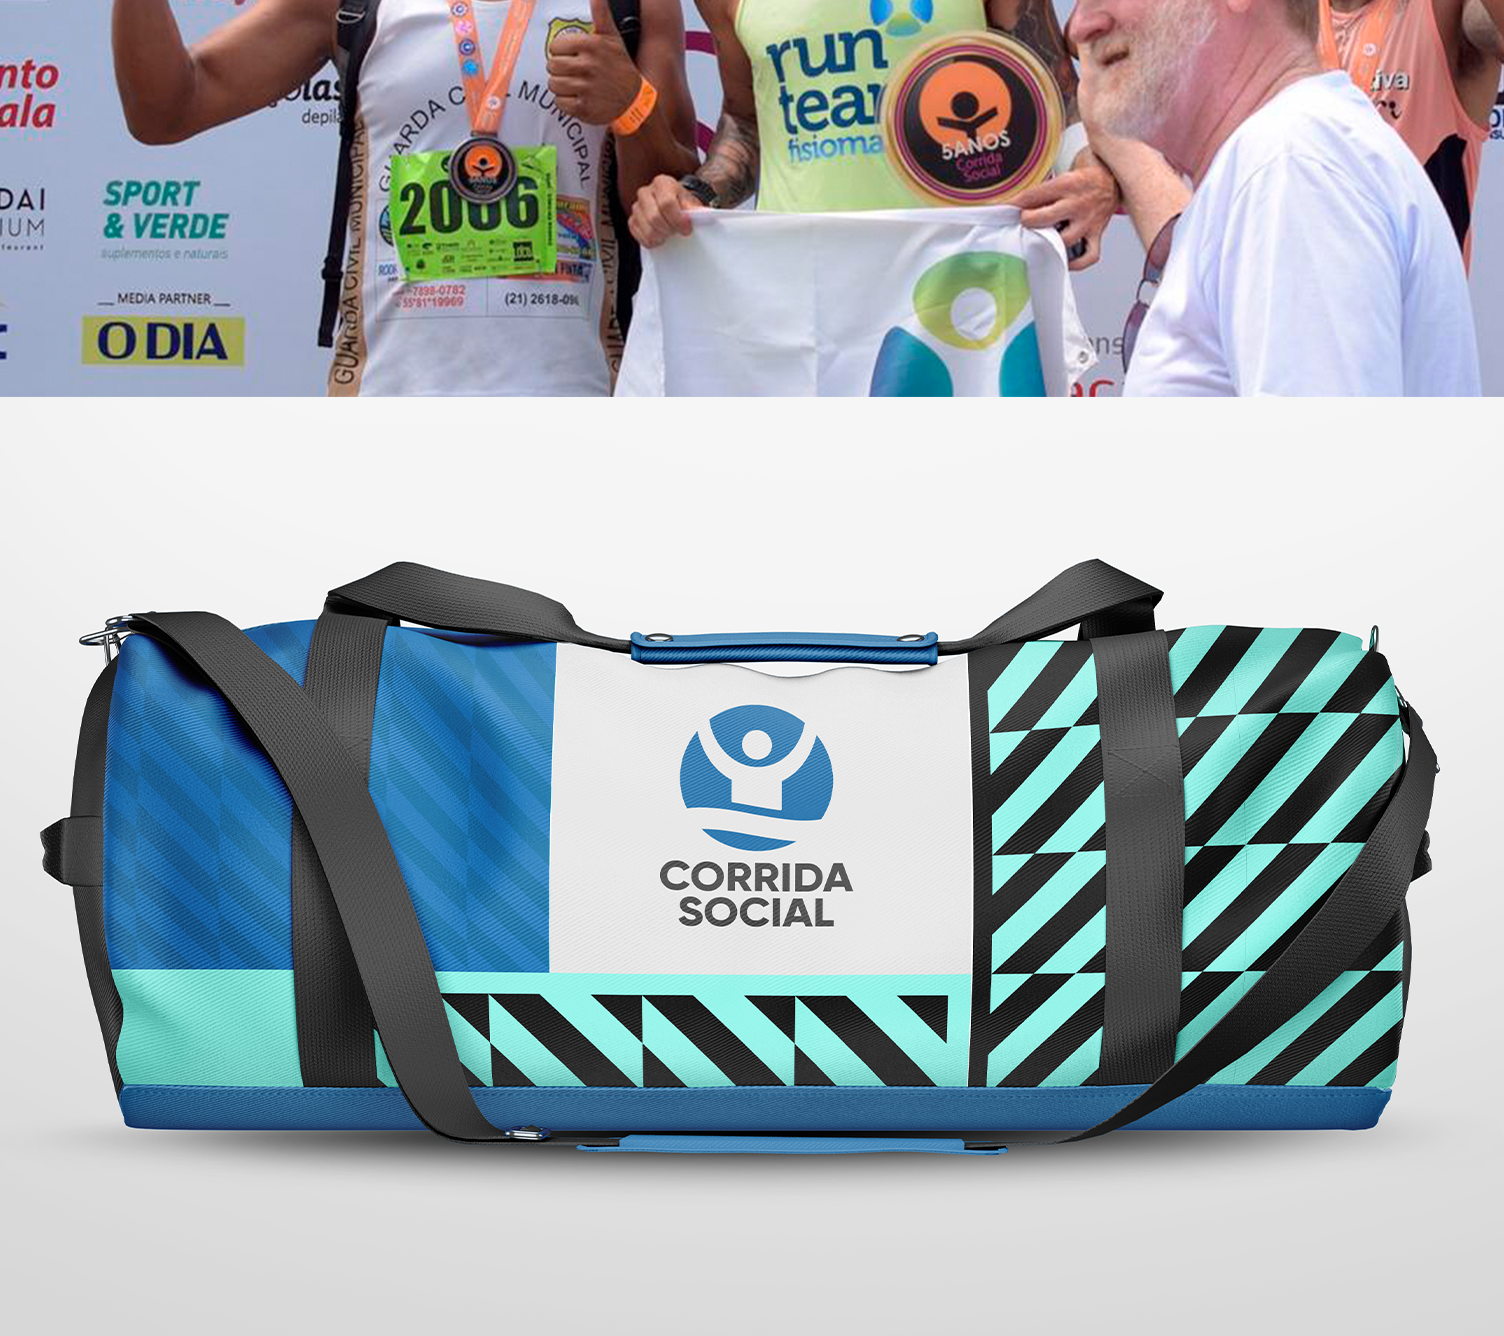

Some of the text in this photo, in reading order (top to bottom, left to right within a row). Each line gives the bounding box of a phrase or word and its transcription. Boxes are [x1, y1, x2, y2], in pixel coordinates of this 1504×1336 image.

[766, 28, 888, 84] run
[378, 98, 446, 193] GARDA
[942, 130, 1011, 161] 5ANOS
[956, 151, 1004, 172] Corrida
[962, 165, 1001, 183] Social
[103, 180, 201, 207] SPORT
[103, 213, 230, 240] & VERDE
[101, 248, 229, 261] suplementos e naturais
[344, 236, 362, 291] CIVIL
[117, 293, 212, 305] MEDIA PARTNER
[505, 292, 528, 307] (21)
[98, 321, 229, 360] O DIA
[334, 296, 360, 385] GUARDA
[659, 859, 854, 892] CORRIDA
[678, 896, 835, 928] SOCIAL
